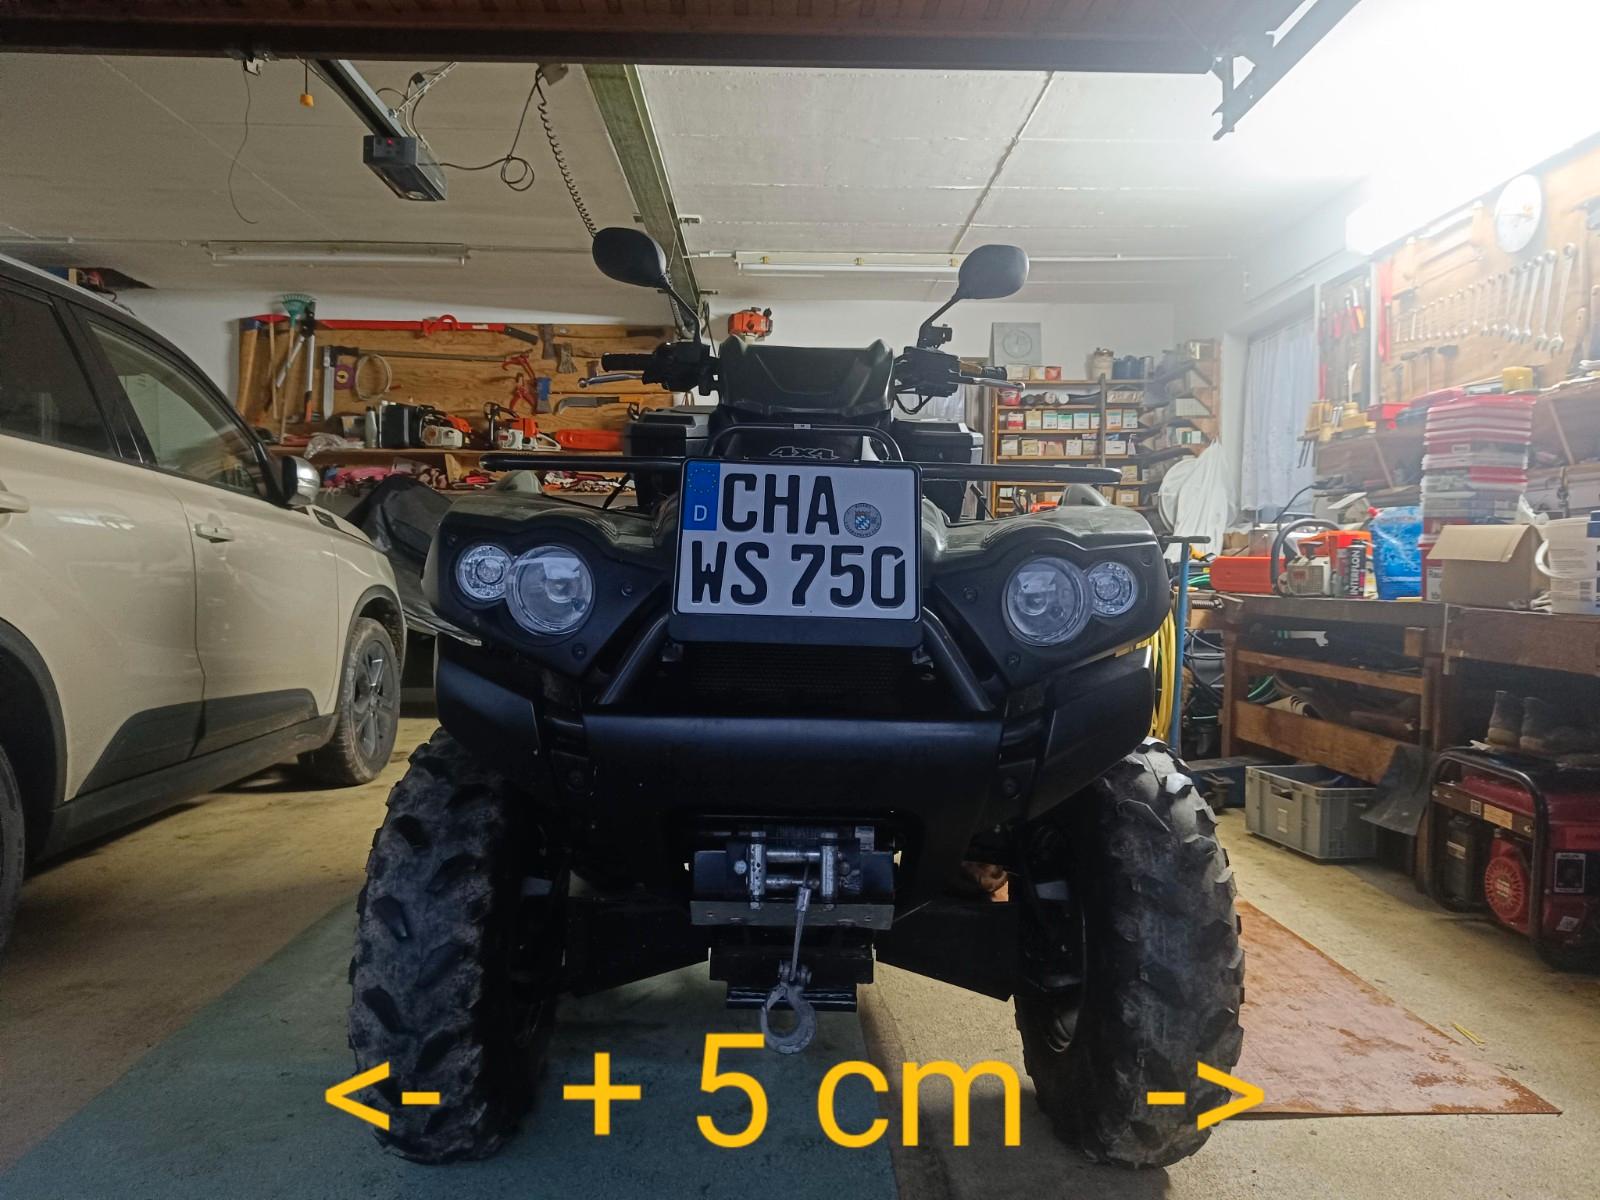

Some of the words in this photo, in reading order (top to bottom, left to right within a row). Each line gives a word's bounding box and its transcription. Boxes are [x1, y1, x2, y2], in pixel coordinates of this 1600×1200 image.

[694, 505, 708, 521] D
[721, 472, 840, 536] CHA
[691, 540, 770, 606] WS
[790, 543, 906, 609] 750
